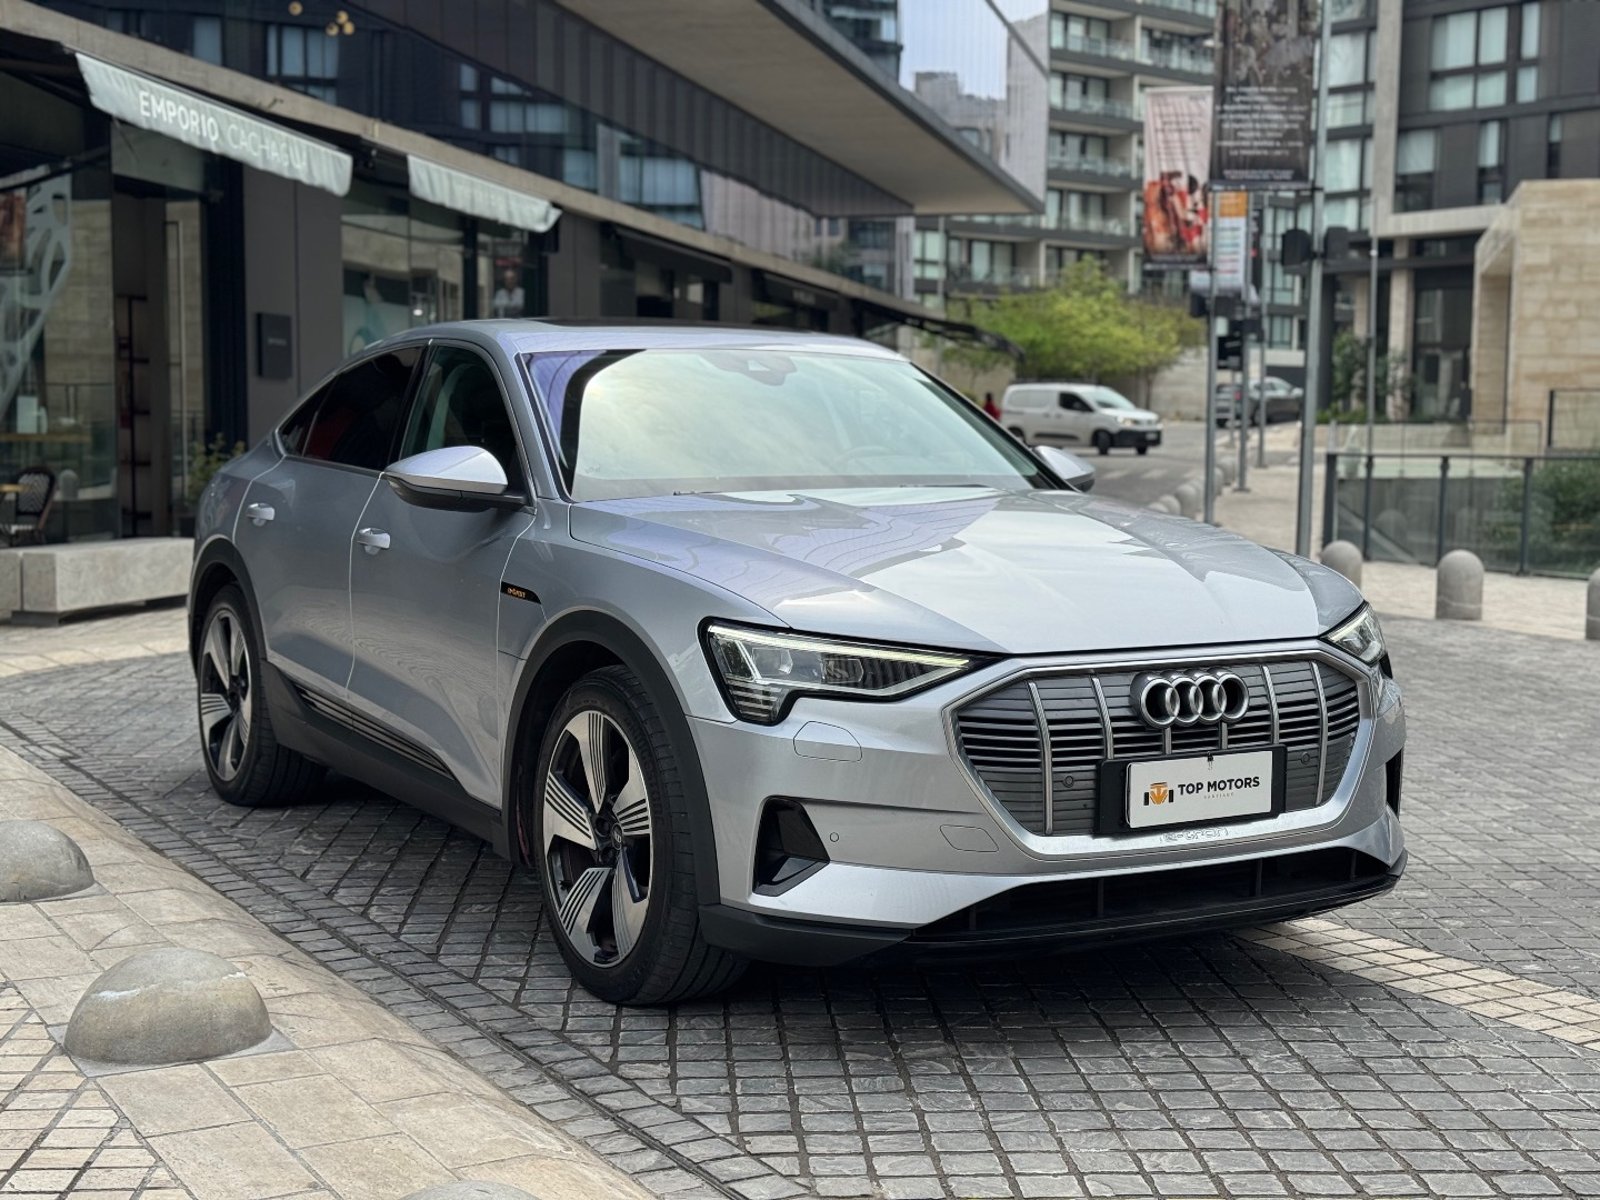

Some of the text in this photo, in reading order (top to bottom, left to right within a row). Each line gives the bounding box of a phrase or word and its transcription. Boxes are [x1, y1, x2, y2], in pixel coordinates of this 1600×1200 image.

[139, 91, 220, 142] EMPORIO
[1178, 777, 1260, 796] TOP MOTORS
